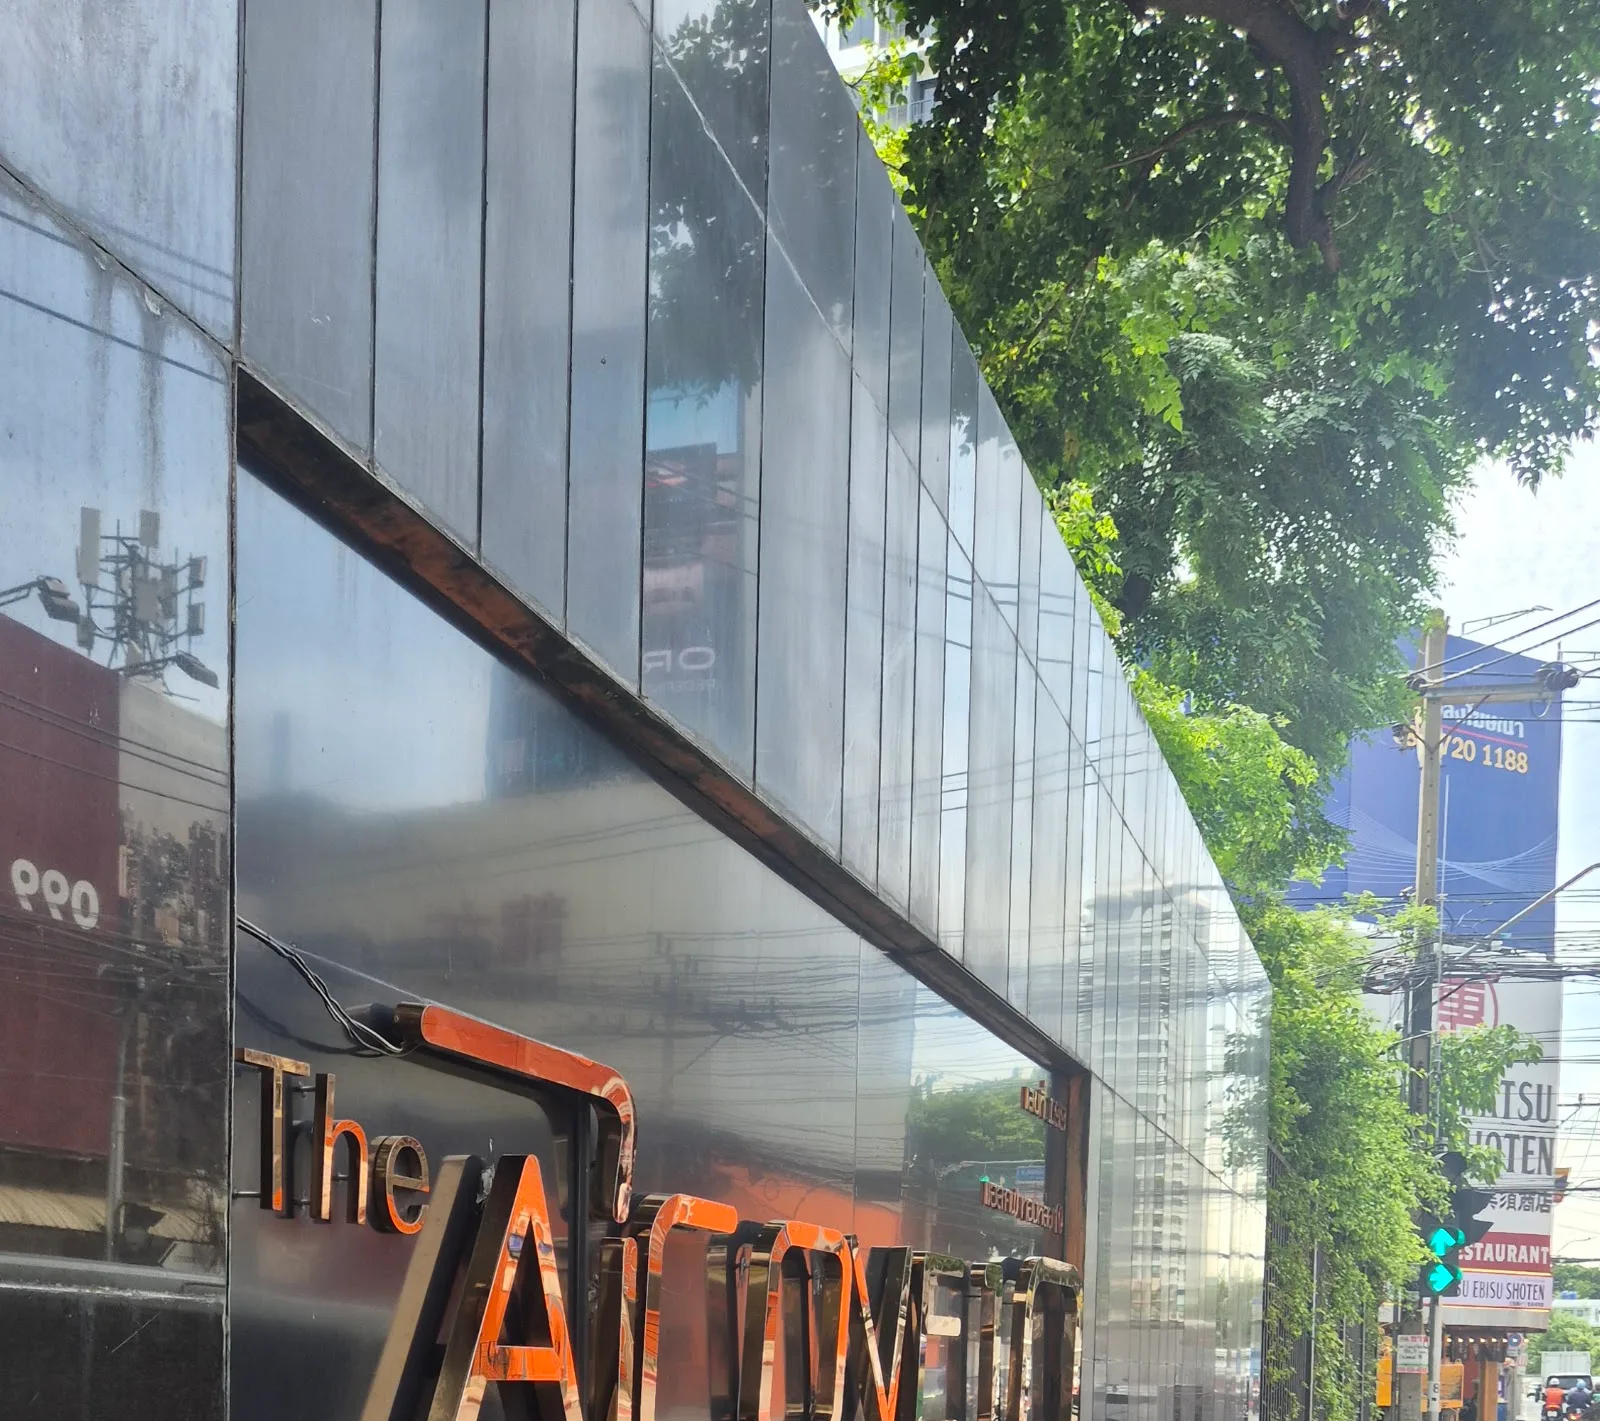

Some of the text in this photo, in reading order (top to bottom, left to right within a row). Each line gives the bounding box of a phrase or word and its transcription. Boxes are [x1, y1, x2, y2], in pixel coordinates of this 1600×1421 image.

[1482, 744, 1528, 774] 1188
[236, 1048, 430, 1235] The
[1473, 1281, 1503, 1300] EBISU
[1506, 1283, 1545, 1301] SHOTEN
